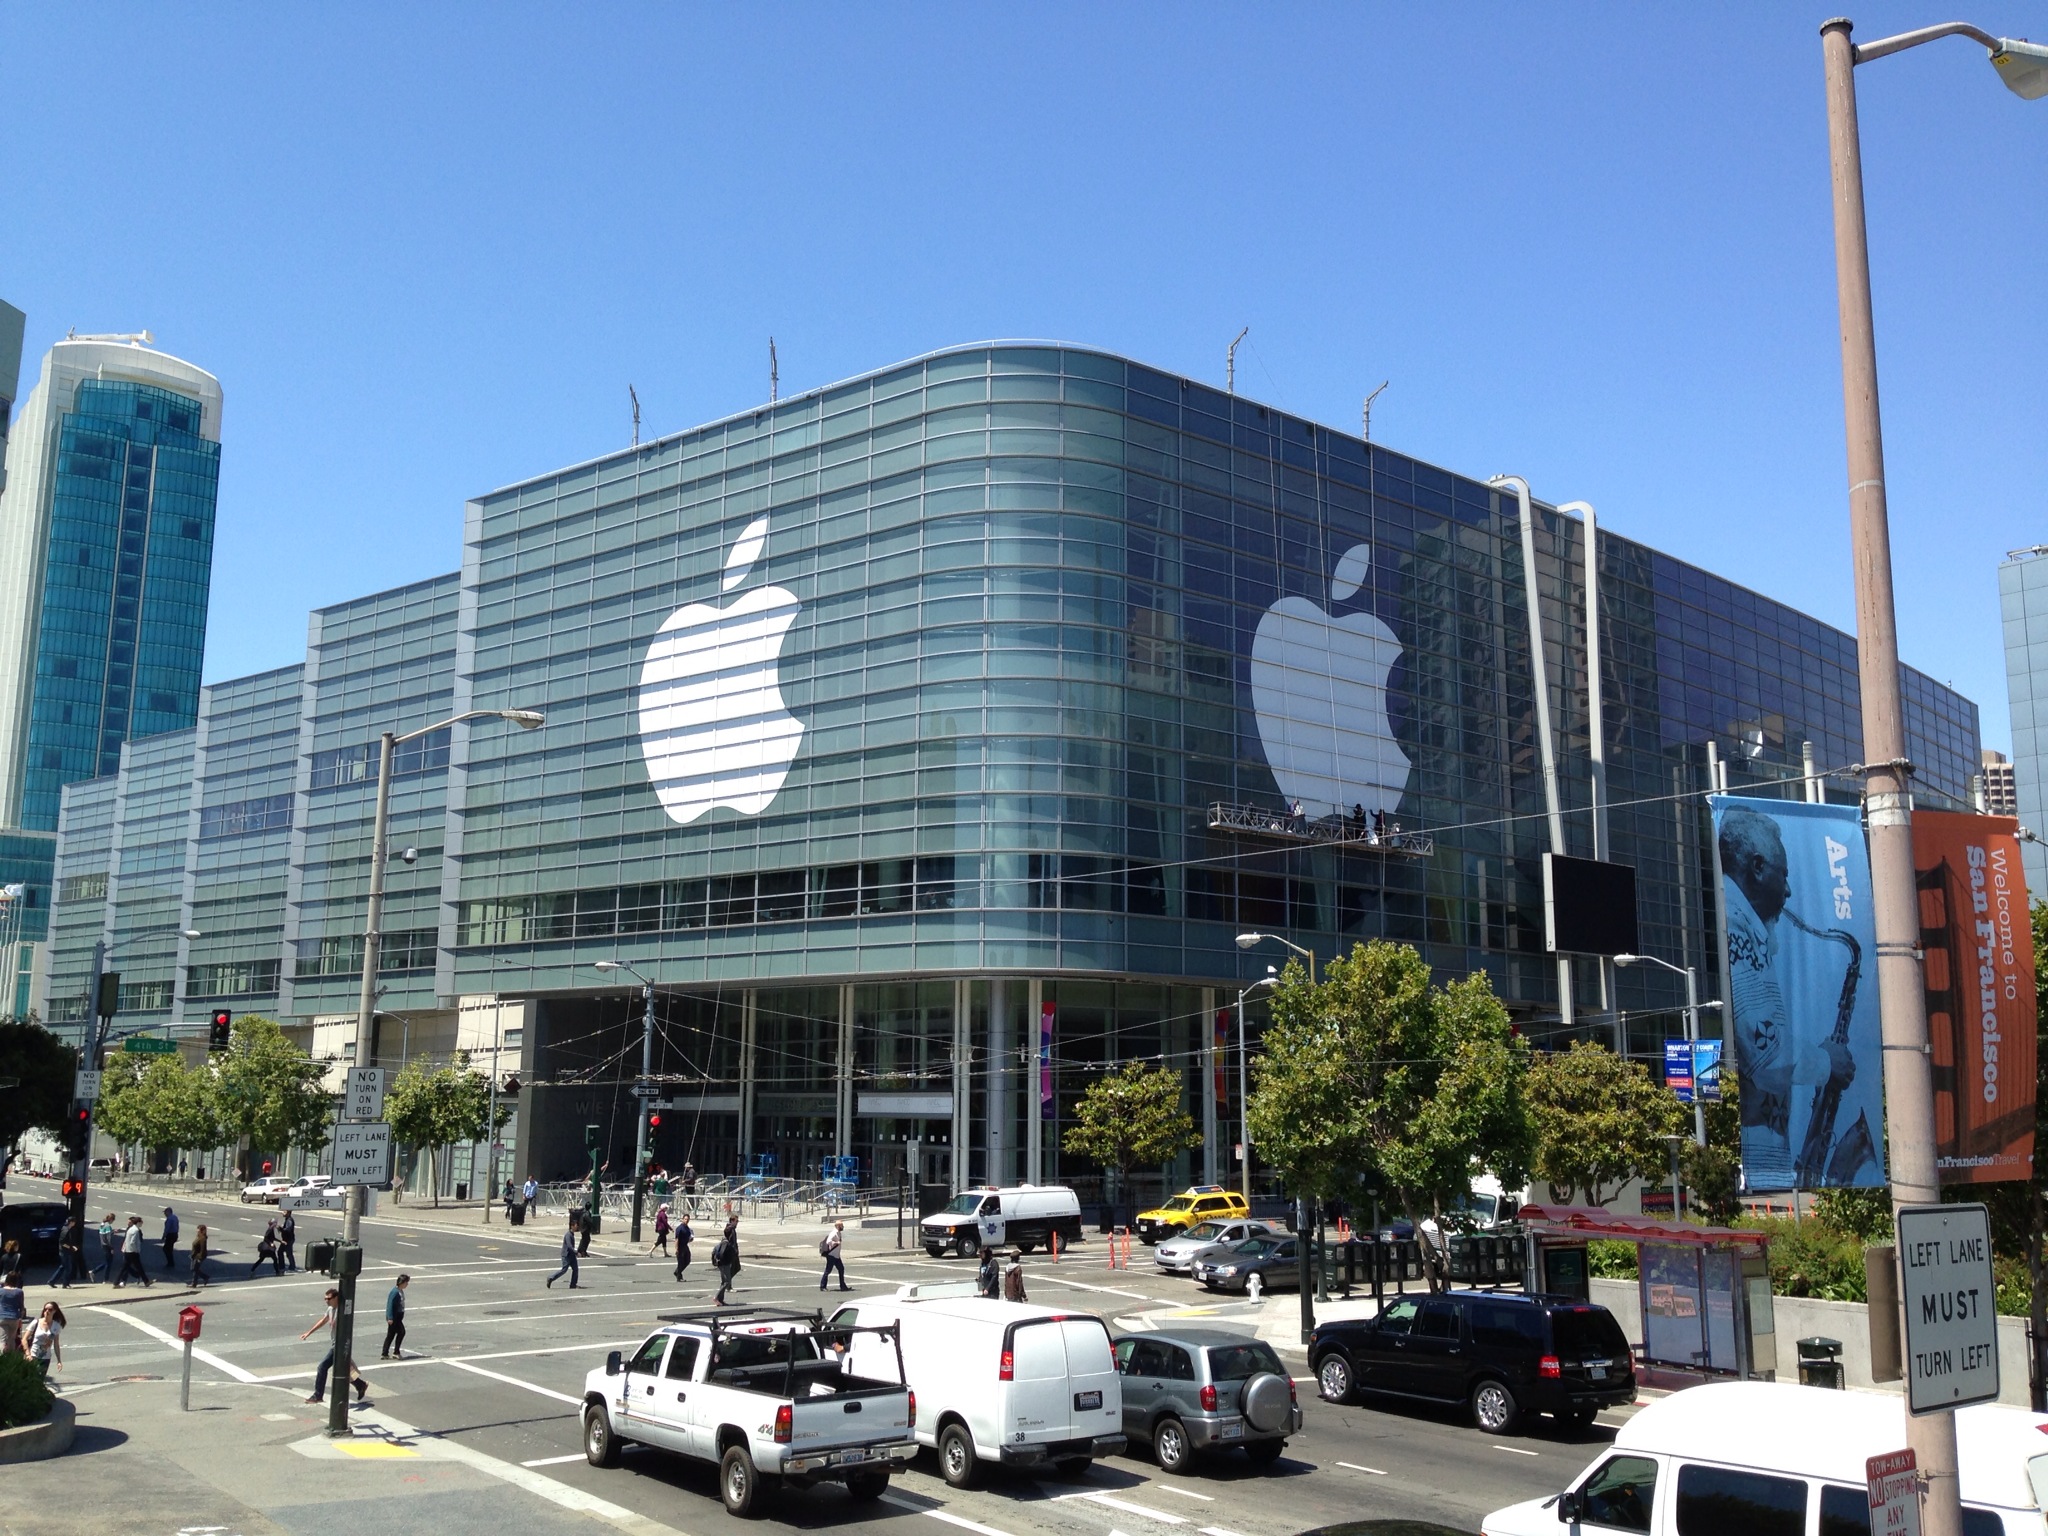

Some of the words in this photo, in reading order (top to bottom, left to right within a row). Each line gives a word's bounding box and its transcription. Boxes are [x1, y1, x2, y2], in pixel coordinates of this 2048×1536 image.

[1825, 836, 1852, 921] Arts
[1966, 845, 1989, 914] San
[1990, 848, 2015, 966] Welcome
[2004, 973, 2018, 1000] to
[1975, 920, 2001, 1103] Francisco
[134, 1042, 151, 1050] 4th
[158, 1041, 169, 1050] St
[358, 1071, 376, 1082] NO
[355, 1084, 377, 1093] TURN
[358, 1095, 372, 1104] ON
[356, 1106, 373, 1115] RED
[340, 1133, 361, 1142] LEFT
[365, 1132, 387, 1141] LANE
[345, 1148, 378, 1160] MUST
[336, 1166, 358, 1176] TURN
[362, 1165, 383, 1175] LEFT
[293, 1199, 311, 1208] 4th
[318, 1199, 330, 1208] St
[1909, 1241, 1941, 1268] LEFT
[1950, 1238, 1984, 1264] LANE
[1922, 1288, 1979, 1325] MUST
[1916, 1350, 1952, 1379] TURN
[1961, 1343, 1991, 1372] LEFT
[1015, 1432, 1026, 1442] 38
[1870, 1454, 1911, 1476] TOW-AWAY
[1869, 1477, 1884, 1505] NO
[1884, 1475, 1916, 1501] STOPPING
[1887, 1504, 1905, 1528] ANY
